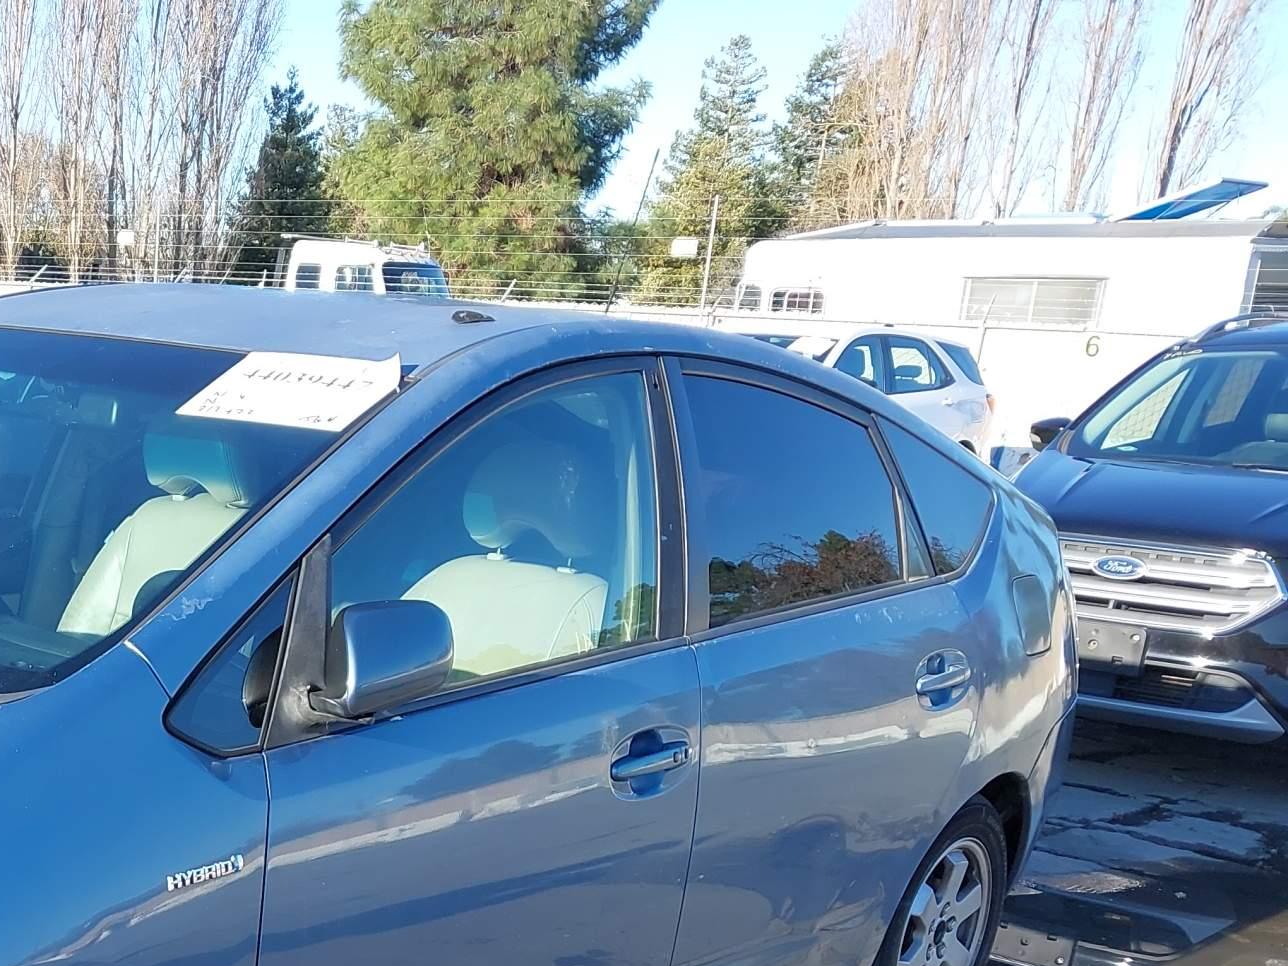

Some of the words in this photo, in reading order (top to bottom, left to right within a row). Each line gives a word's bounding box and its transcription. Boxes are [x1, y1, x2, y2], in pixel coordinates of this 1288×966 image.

[1085, 335, 1101, 358] 6
[1103, 559, 1137, 574] Ford
[166, 860, 235, 892] HYBRID
